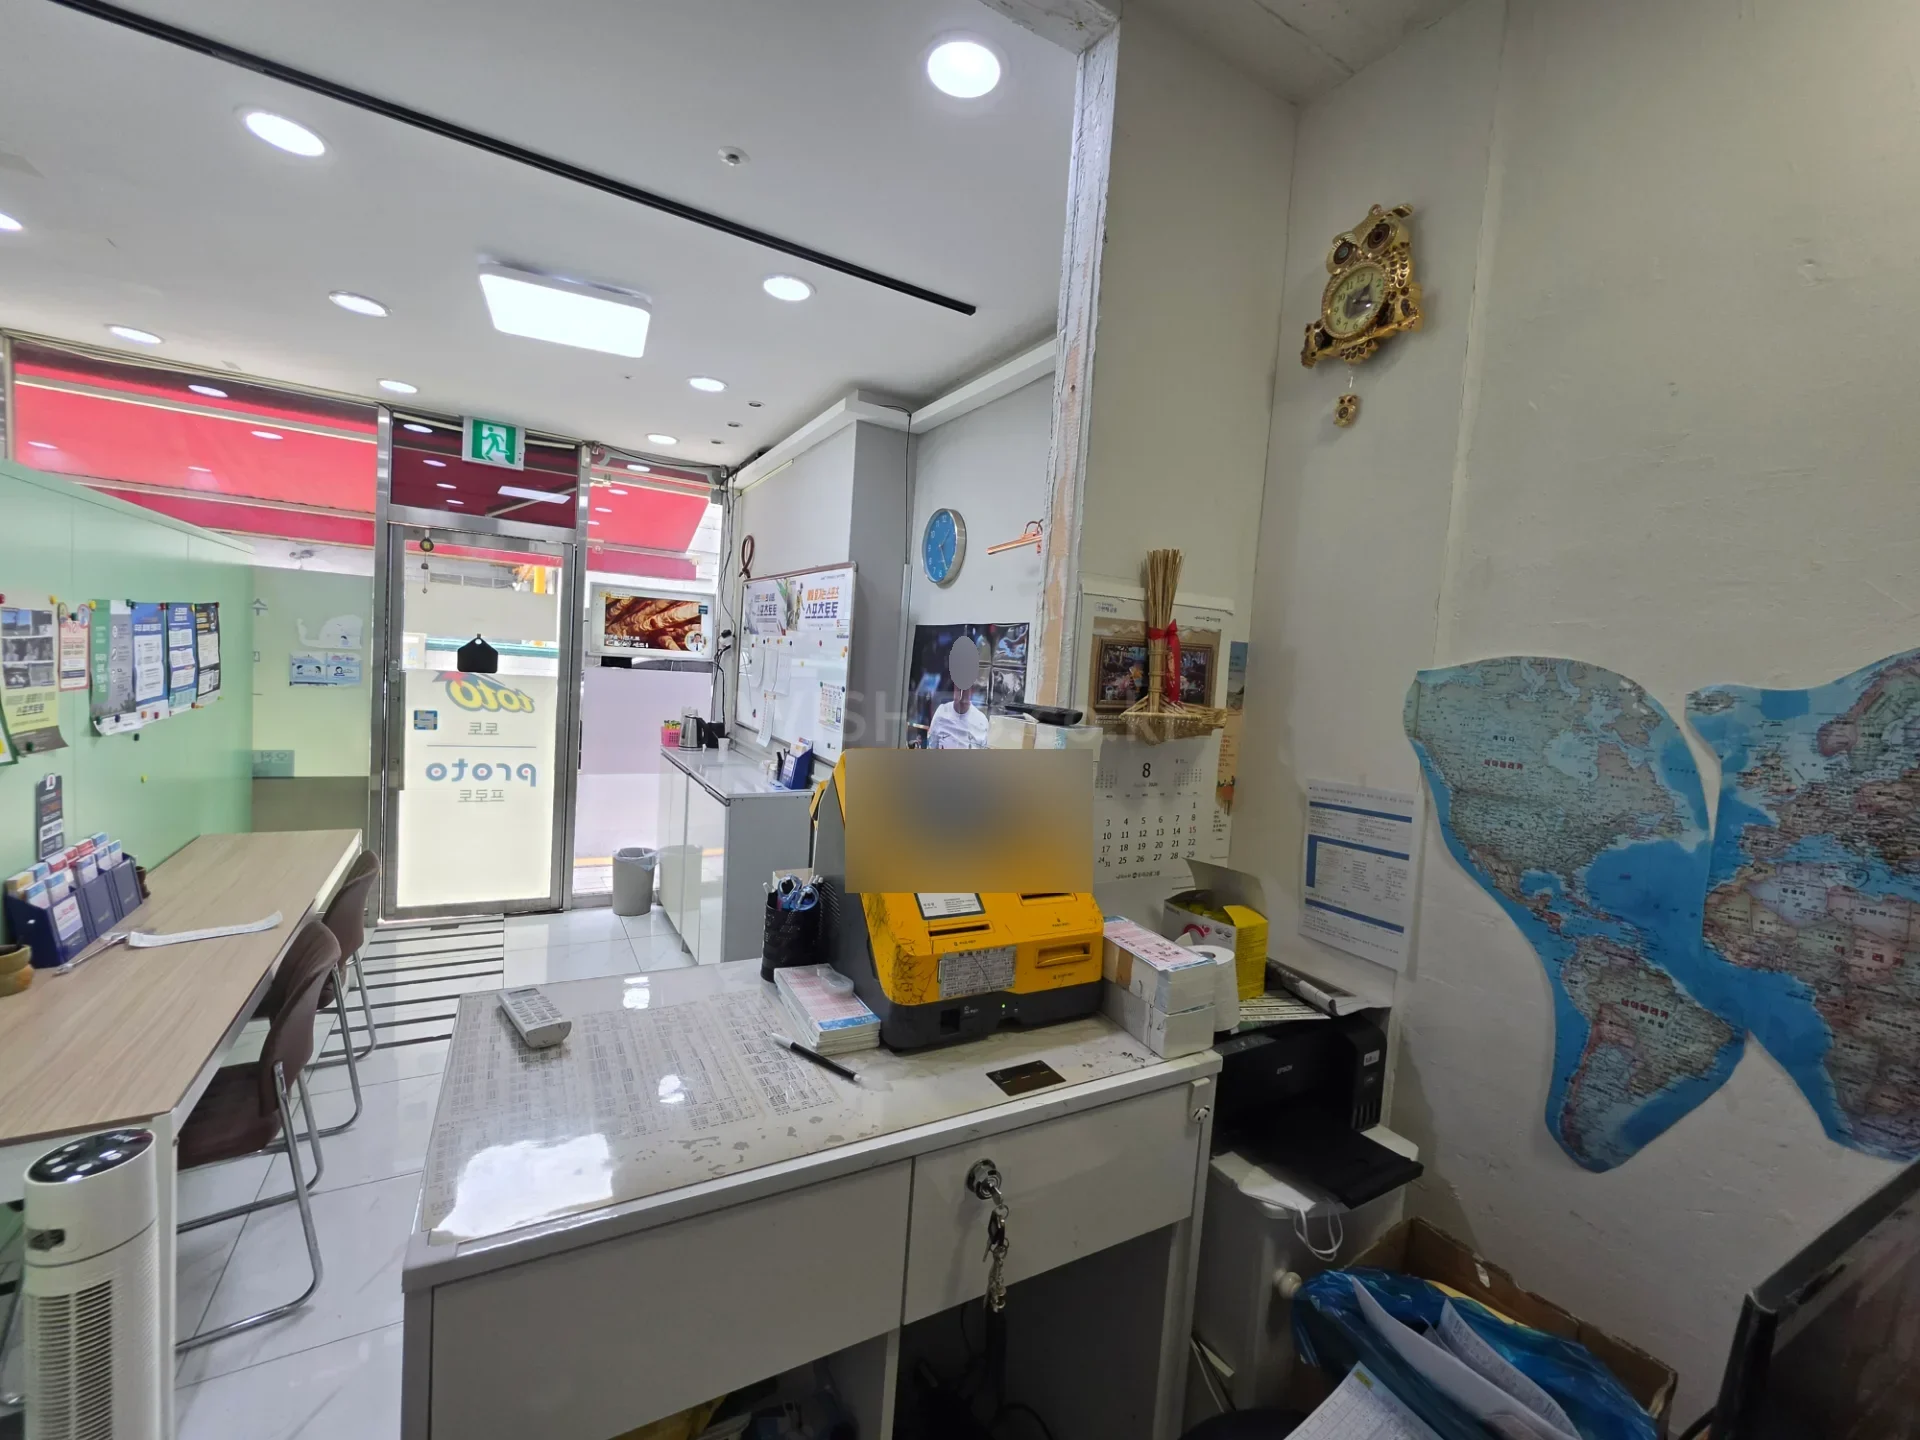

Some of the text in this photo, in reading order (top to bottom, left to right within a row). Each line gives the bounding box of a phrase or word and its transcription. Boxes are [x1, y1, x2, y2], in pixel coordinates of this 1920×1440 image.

[804, 602, 839, 619] 스포츠토토
[1142, 762, 1152, 778] 8
[1106, 819, 1111, 827] 3
[1124, 818, 1128, 826] 4
[1141, 816, 1146, 825] 5
[1158, 815, 1163, 824] 6
[1175, 814, 1180, 822] 7
[1103, 826, 1196, 840] 10 11 12 13 14 15
[1102, 838, 1196, 853] 17 18 19 20 21 22
[1118, 856, 1127, 864] 25
[1136, 855, 1145, 863] 26
[1153, 853, 1162, 861] 27
[1170, 852, 1179, 860] 28
